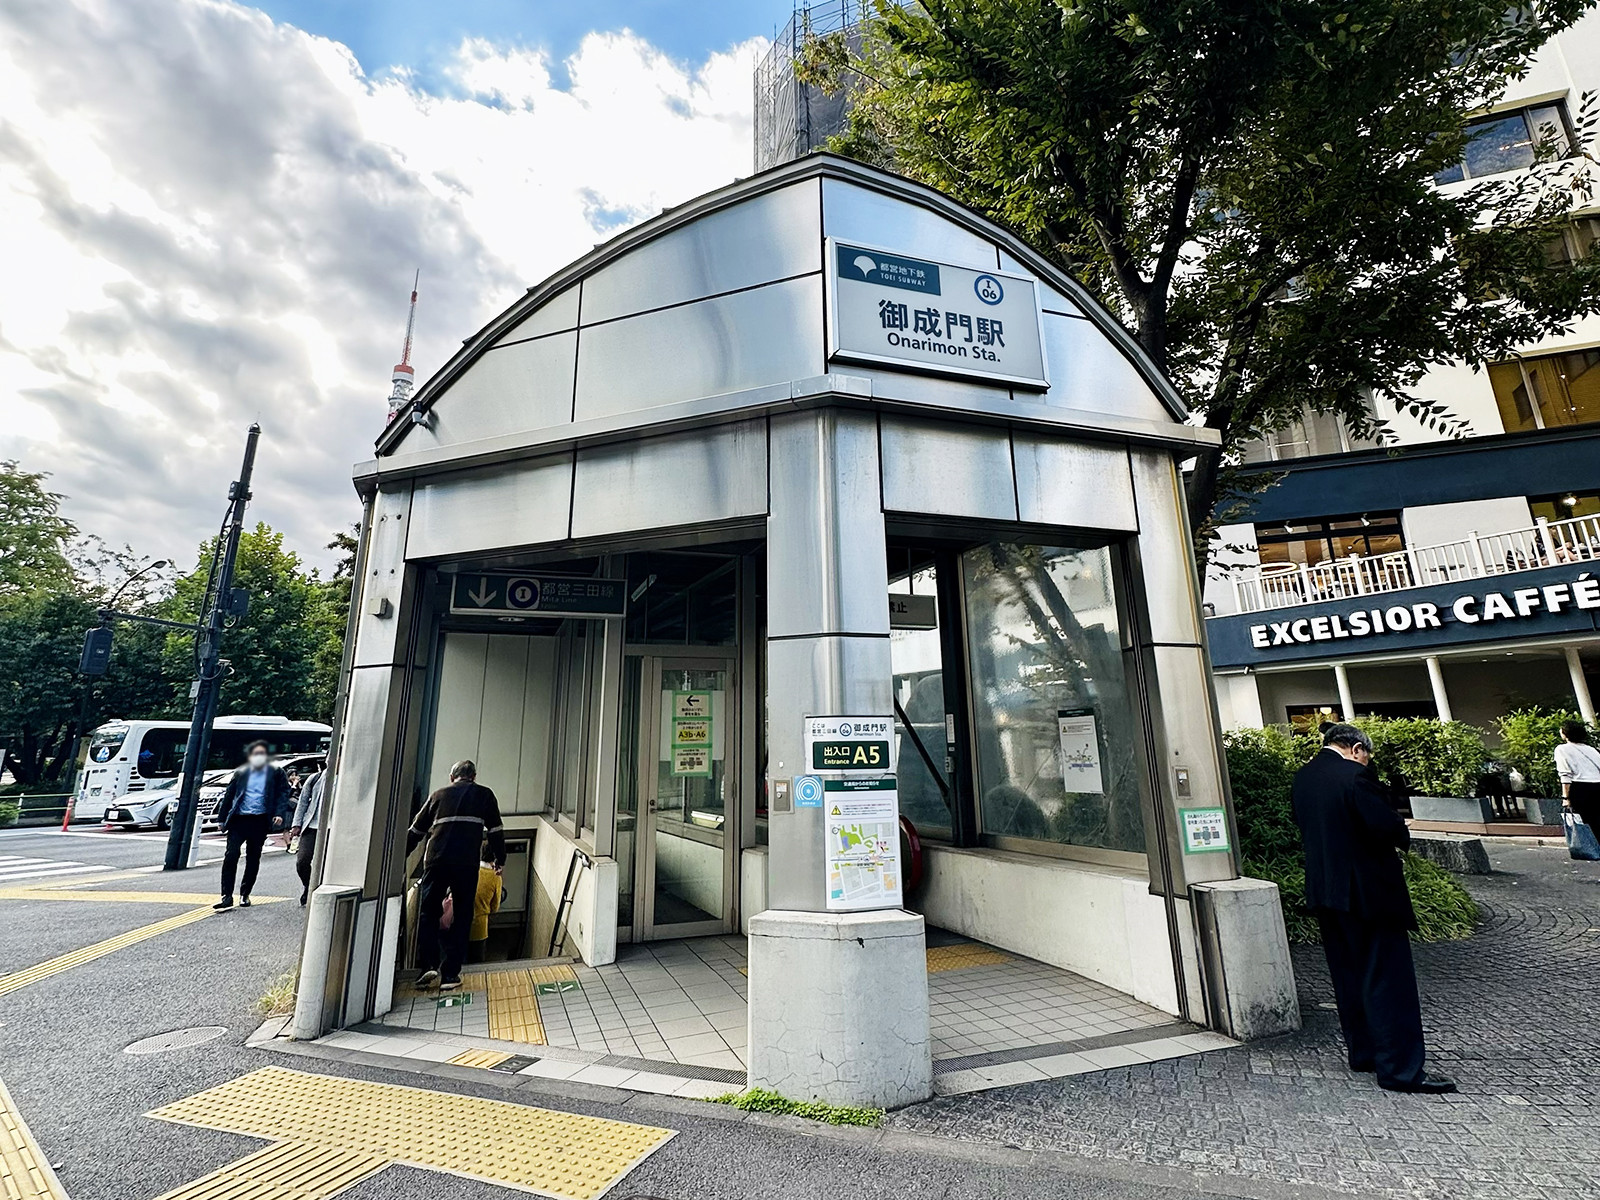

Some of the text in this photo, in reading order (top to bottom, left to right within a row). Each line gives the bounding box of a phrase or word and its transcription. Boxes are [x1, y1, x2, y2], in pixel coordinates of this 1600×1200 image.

[880, 262, 926, 279] 都営地下鉄
[880, 272, 926, 287] TOEI SUBWAY
[982, 289, 997, 300] 06
[878, 299, 1005, 348] 御成門駅
[887, 332, 1001, 362] Onarimon Sta.
[542, 582, 614, 598] 都営三田線
[1250, 572, 1600, 649] EXCELSIOR CAFFÉ
[854, 723, 887, 732] 御成門駅
[823, 746, 850, 756] 出入口
[852, 745, 880, 765] A5
